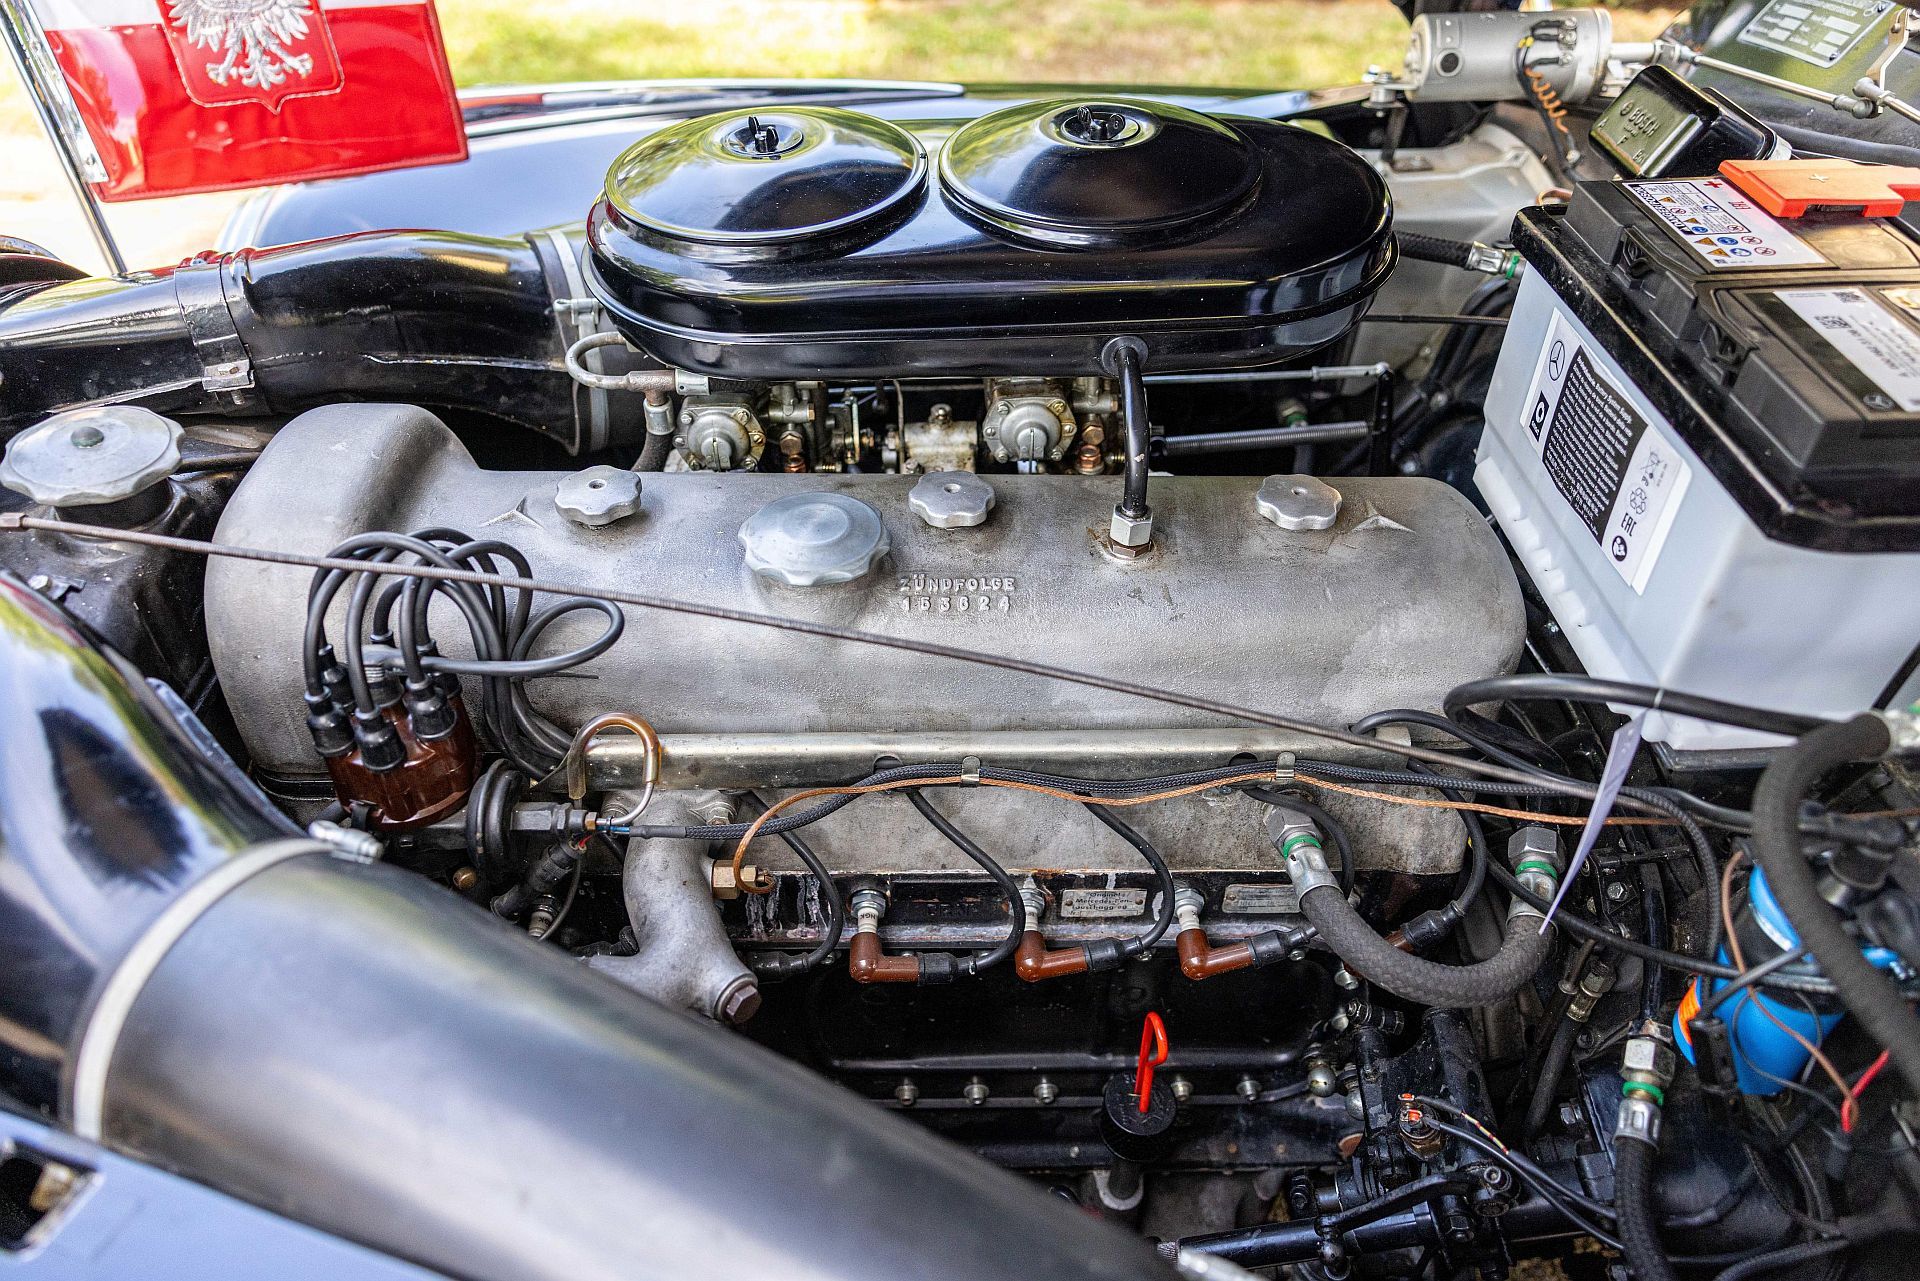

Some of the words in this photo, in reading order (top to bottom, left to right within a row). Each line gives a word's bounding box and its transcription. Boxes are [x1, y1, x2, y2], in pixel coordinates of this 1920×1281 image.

[1629, 107, 1661, 137] BOSCH
[1620, 512, 1637, 537] EAC
[899, 574, 1016, 592] ZÜNDFOLGE
